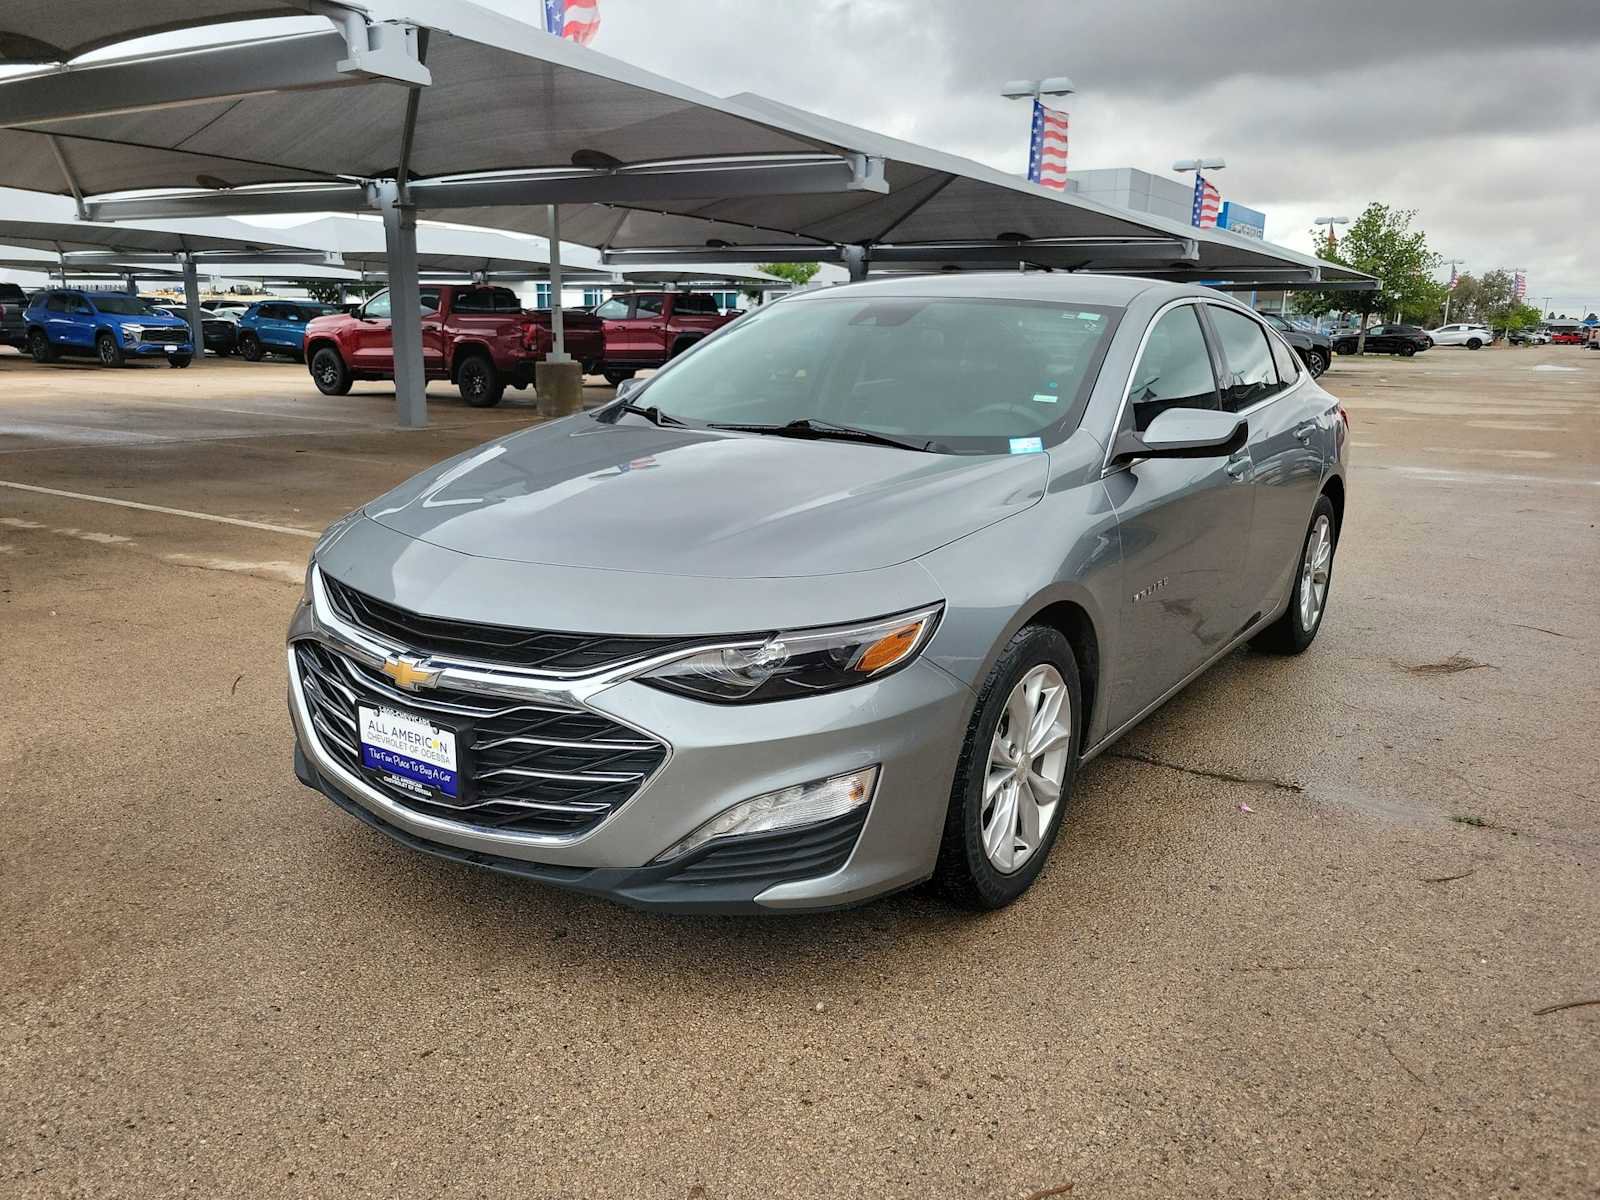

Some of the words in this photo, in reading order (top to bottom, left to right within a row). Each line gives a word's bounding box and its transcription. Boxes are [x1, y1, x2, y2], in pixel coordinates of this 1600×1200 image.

[368, 719, 388, 735] ALL
[367, 731, 408, 751] CHEVROLET
[368, 747, 380, 759] The
[393, 755, 410, 769] Place
[410, 761, 419, 772] To
[432, 768, 440, 780] A
[439, 771, 451, 782] Car
